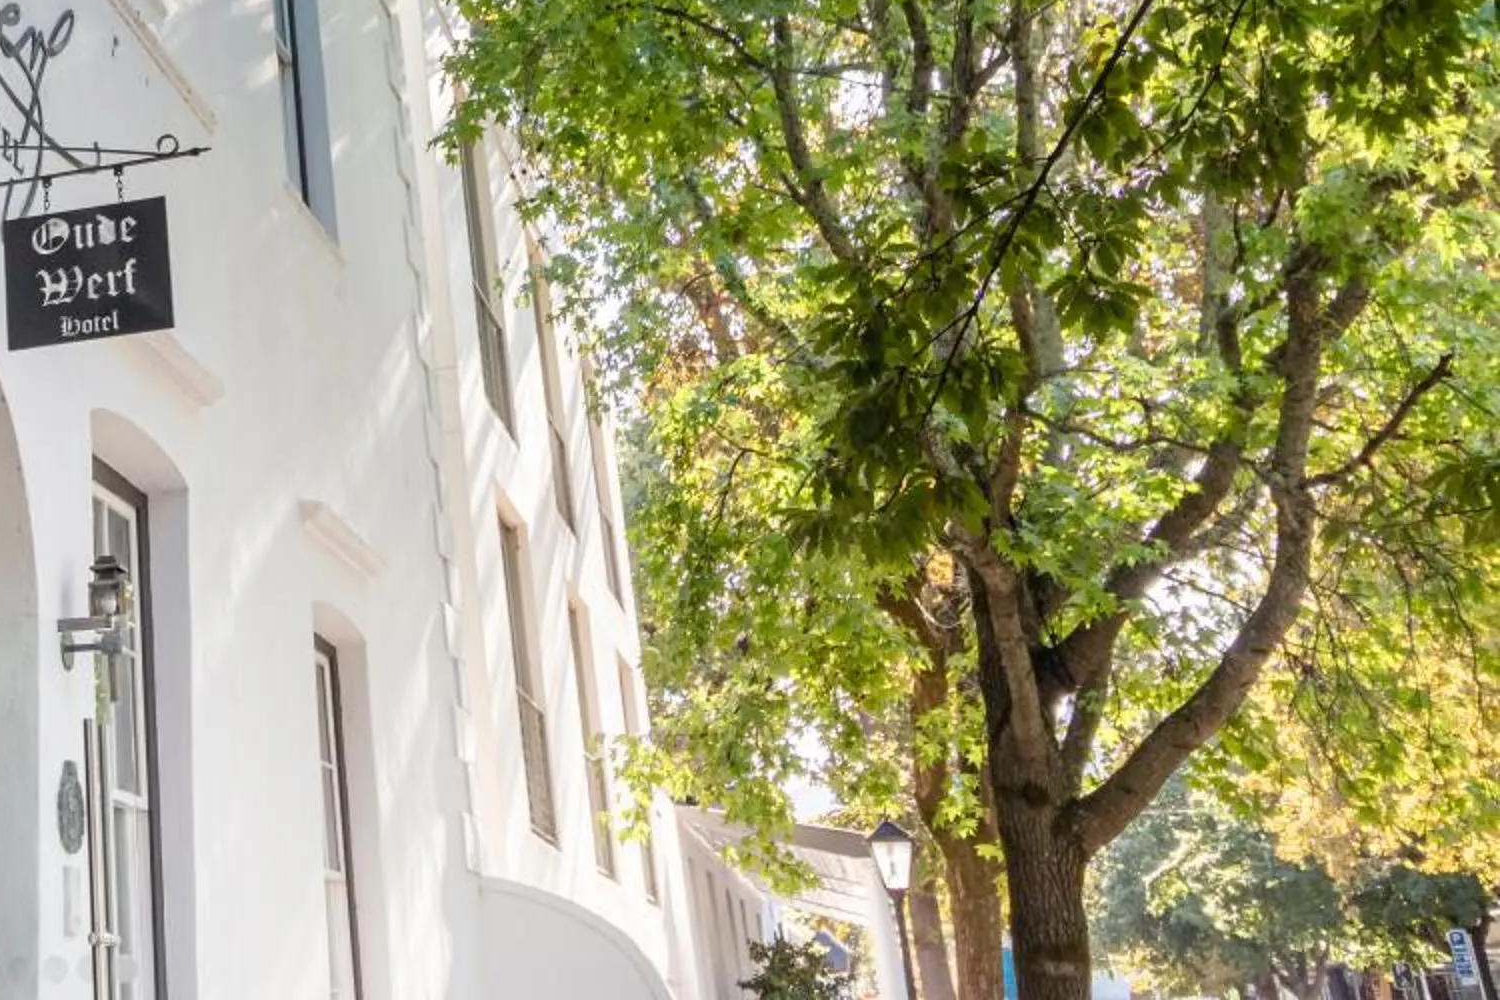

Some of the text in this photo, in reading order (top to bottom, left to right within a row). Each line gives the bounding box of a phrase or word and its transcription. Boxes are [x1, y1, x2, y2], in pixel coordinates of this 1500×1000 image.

[31, 213, 137, 255] Oude
[35, 256, 138, 307] Werf
[59, 309, 120, 337] Hotel
